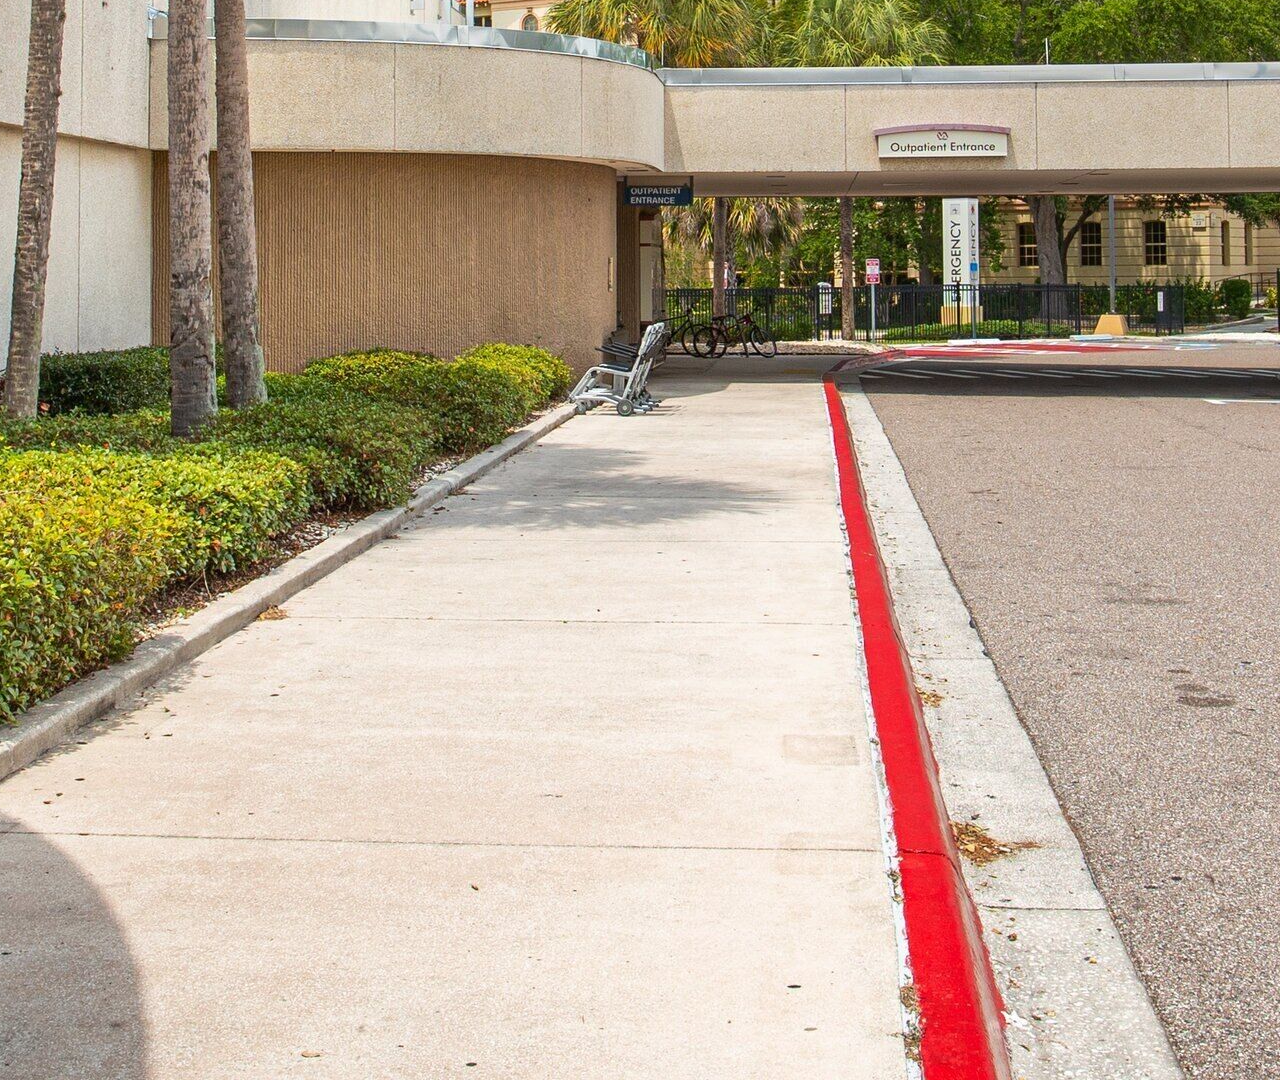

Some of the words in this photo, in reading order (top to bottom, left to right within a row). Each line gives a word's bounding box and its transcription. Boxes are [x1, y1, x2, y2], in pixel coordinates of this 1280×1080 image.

[890, 142, 947, 154] Outpatient
[950, 142, 996, 152] Entrance
[630, 187, 681, 195] OUTPATIENT
[630, 196, 676, 204] ENTRANCE
